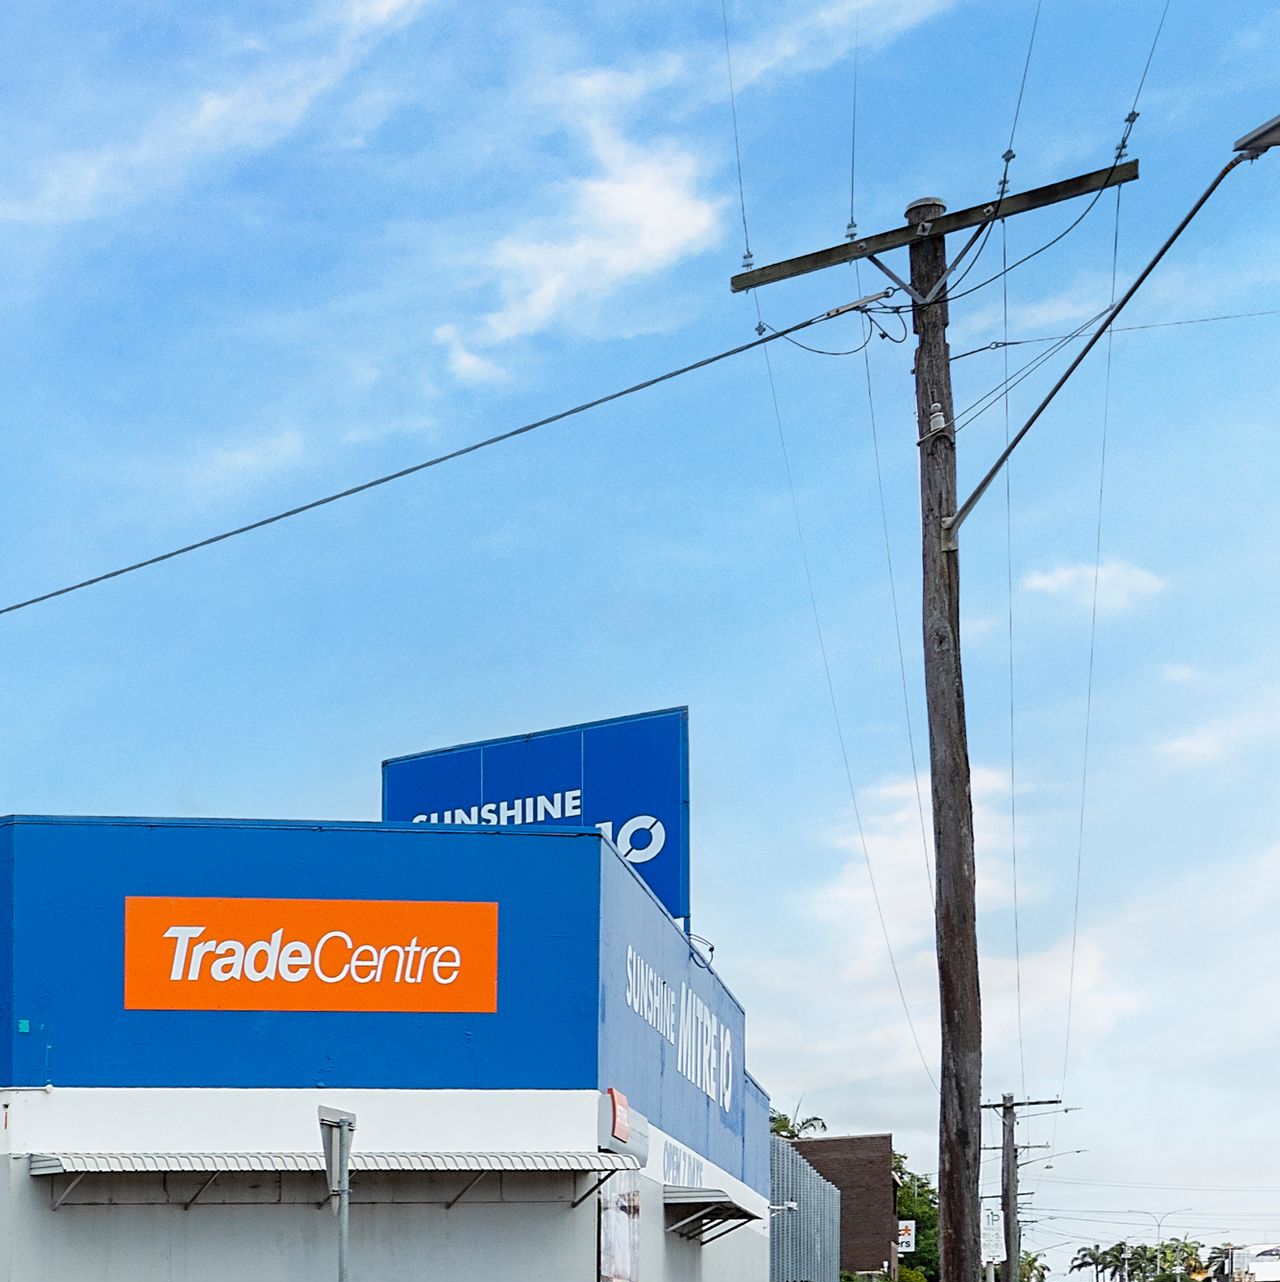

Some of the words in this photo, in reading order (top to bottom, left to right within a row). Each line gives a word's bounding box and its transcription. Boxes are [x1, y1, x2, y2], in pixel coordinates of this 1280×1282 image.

[412, 789, 582, 825] NSHINE
[162, 925, 462, 985] TradeCentre
[625, 944, 676, 1046] SUNSHINE
[676, 981, 718, 1102] MITRE
[718, 1022, 733, 1113] 10
